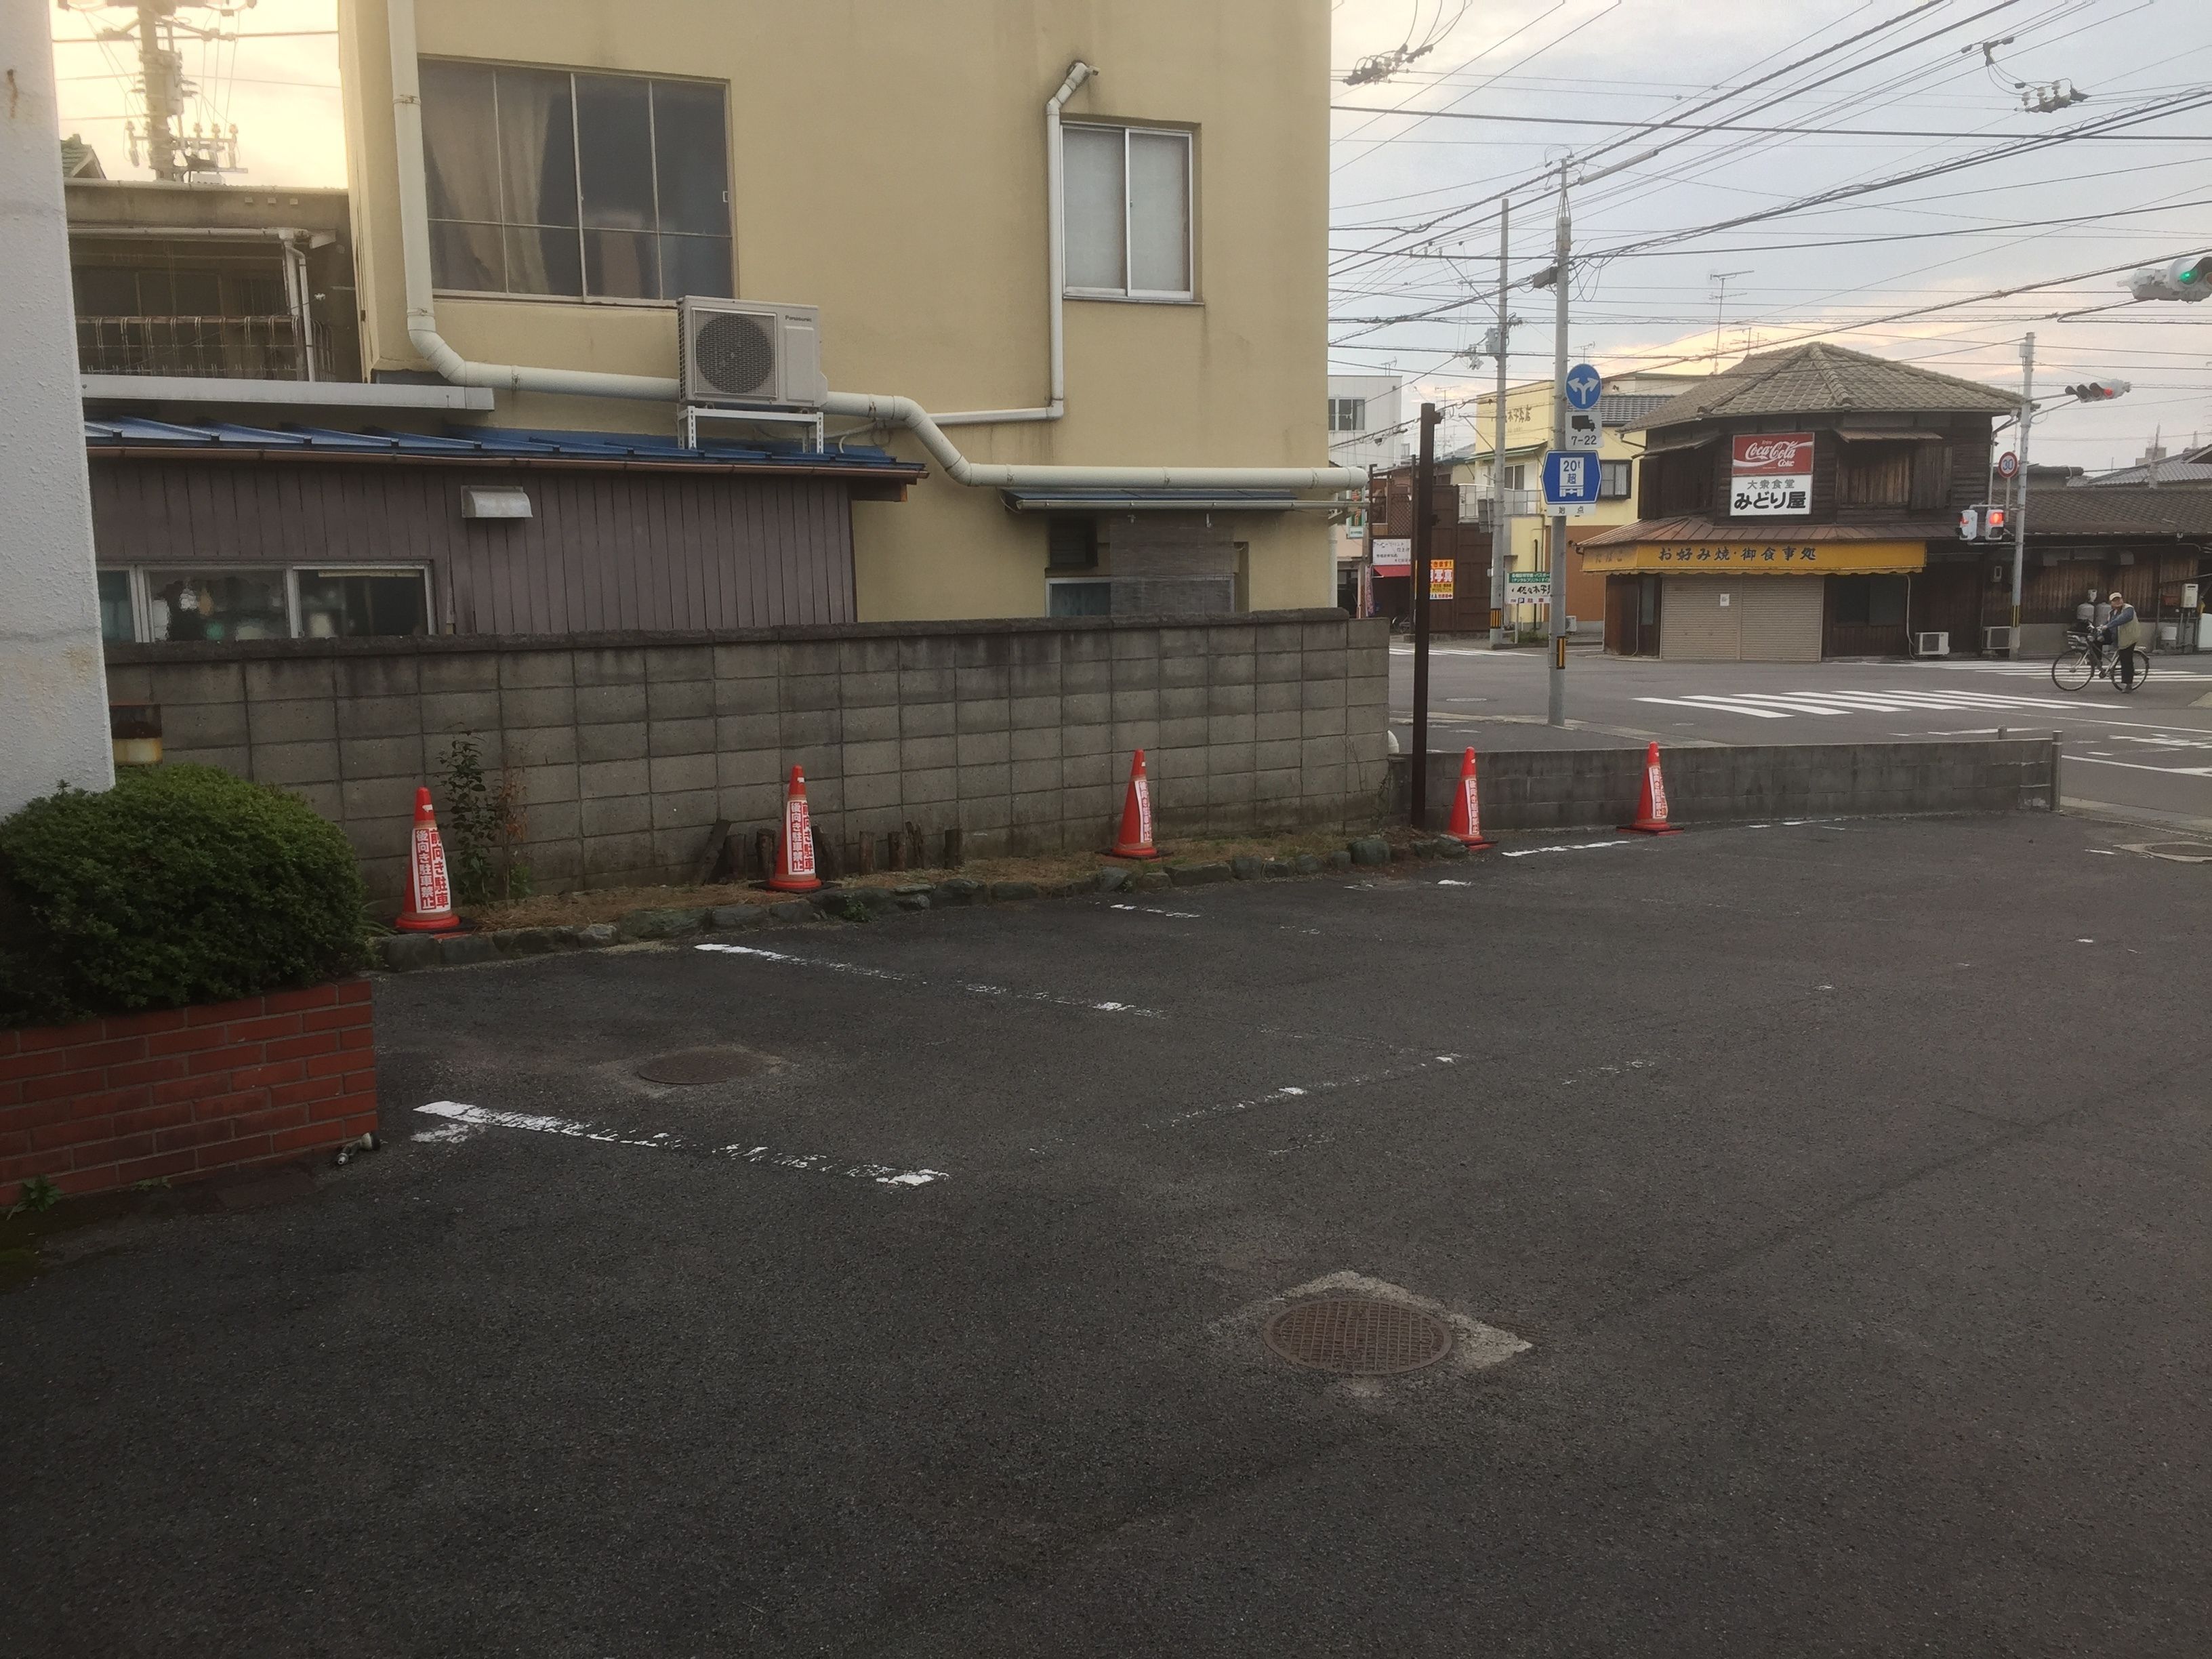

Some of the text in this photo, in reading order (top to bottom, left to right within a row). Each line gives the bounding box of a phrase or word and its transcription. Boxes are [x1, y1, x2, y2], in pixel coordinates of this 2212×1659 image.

[1571, 435, 1597, 445] 7-22
[1745, 441, 1799, 460] Coca-Cola
[1778, 459, 1795, 468] Coke
[2003, 459, 2013, 470] 30
[1567, 473, 1576, 485] 超
[1747, 478, 1795, 490] 大衆食堂
[1734, 490, 1806, 510] みどり屋
[1558, 506, 1584, 514] 始点
[1658, 546, 1817, 562] お好み焼・御食事処
[791, 802, 804, 872] 後向き駐車禁止
[415, 830, 436, 910] 後向き駐車禁止
[429, 828, 449, 908] 前向き駐車
